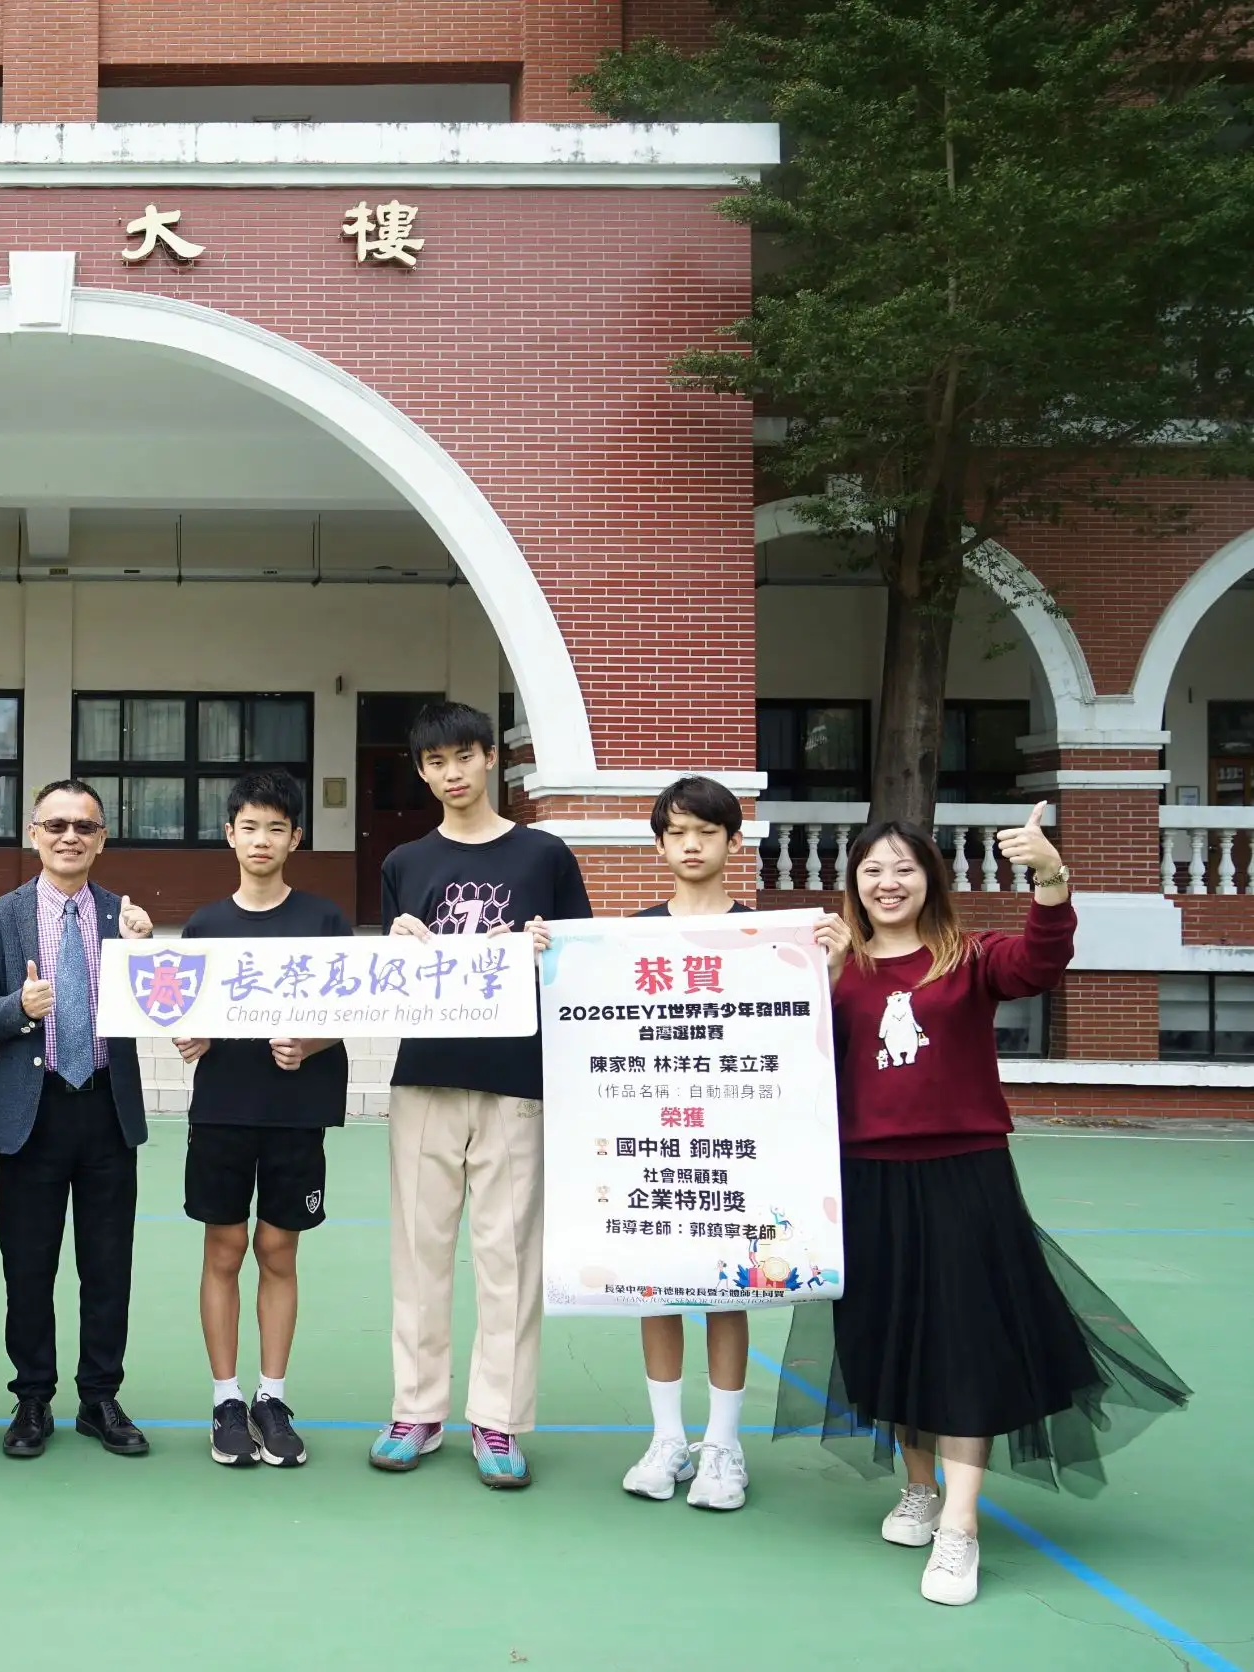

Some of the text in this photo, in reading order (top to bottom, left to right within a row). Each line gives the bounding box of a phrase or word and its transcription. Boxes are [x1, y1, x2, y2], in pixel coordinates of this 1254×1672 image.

[221, 946, 512, 1001] 長榮高級中學
[634, 955, 725, 995] 恭賀
[226, 1003, 499, 1025] Chang Jung senior high school
[558, 1001, 811, 1021] 2026IEYI世界青少年發明展
[639, 1025, 724, 1040] 台灣選拔賽
[653, 1056, 711, 1073] 林洋右
[719, 1055, 779, 1073] 葉立澤
[660, 1107, 705, 1128] 榮獲
[616, 1138, 757, 1160] 國中組 銅牌獎
[643, 1168, 728, 1185] 社會照顧類
[627, 1189, 746, 1212] 企業特別獎
